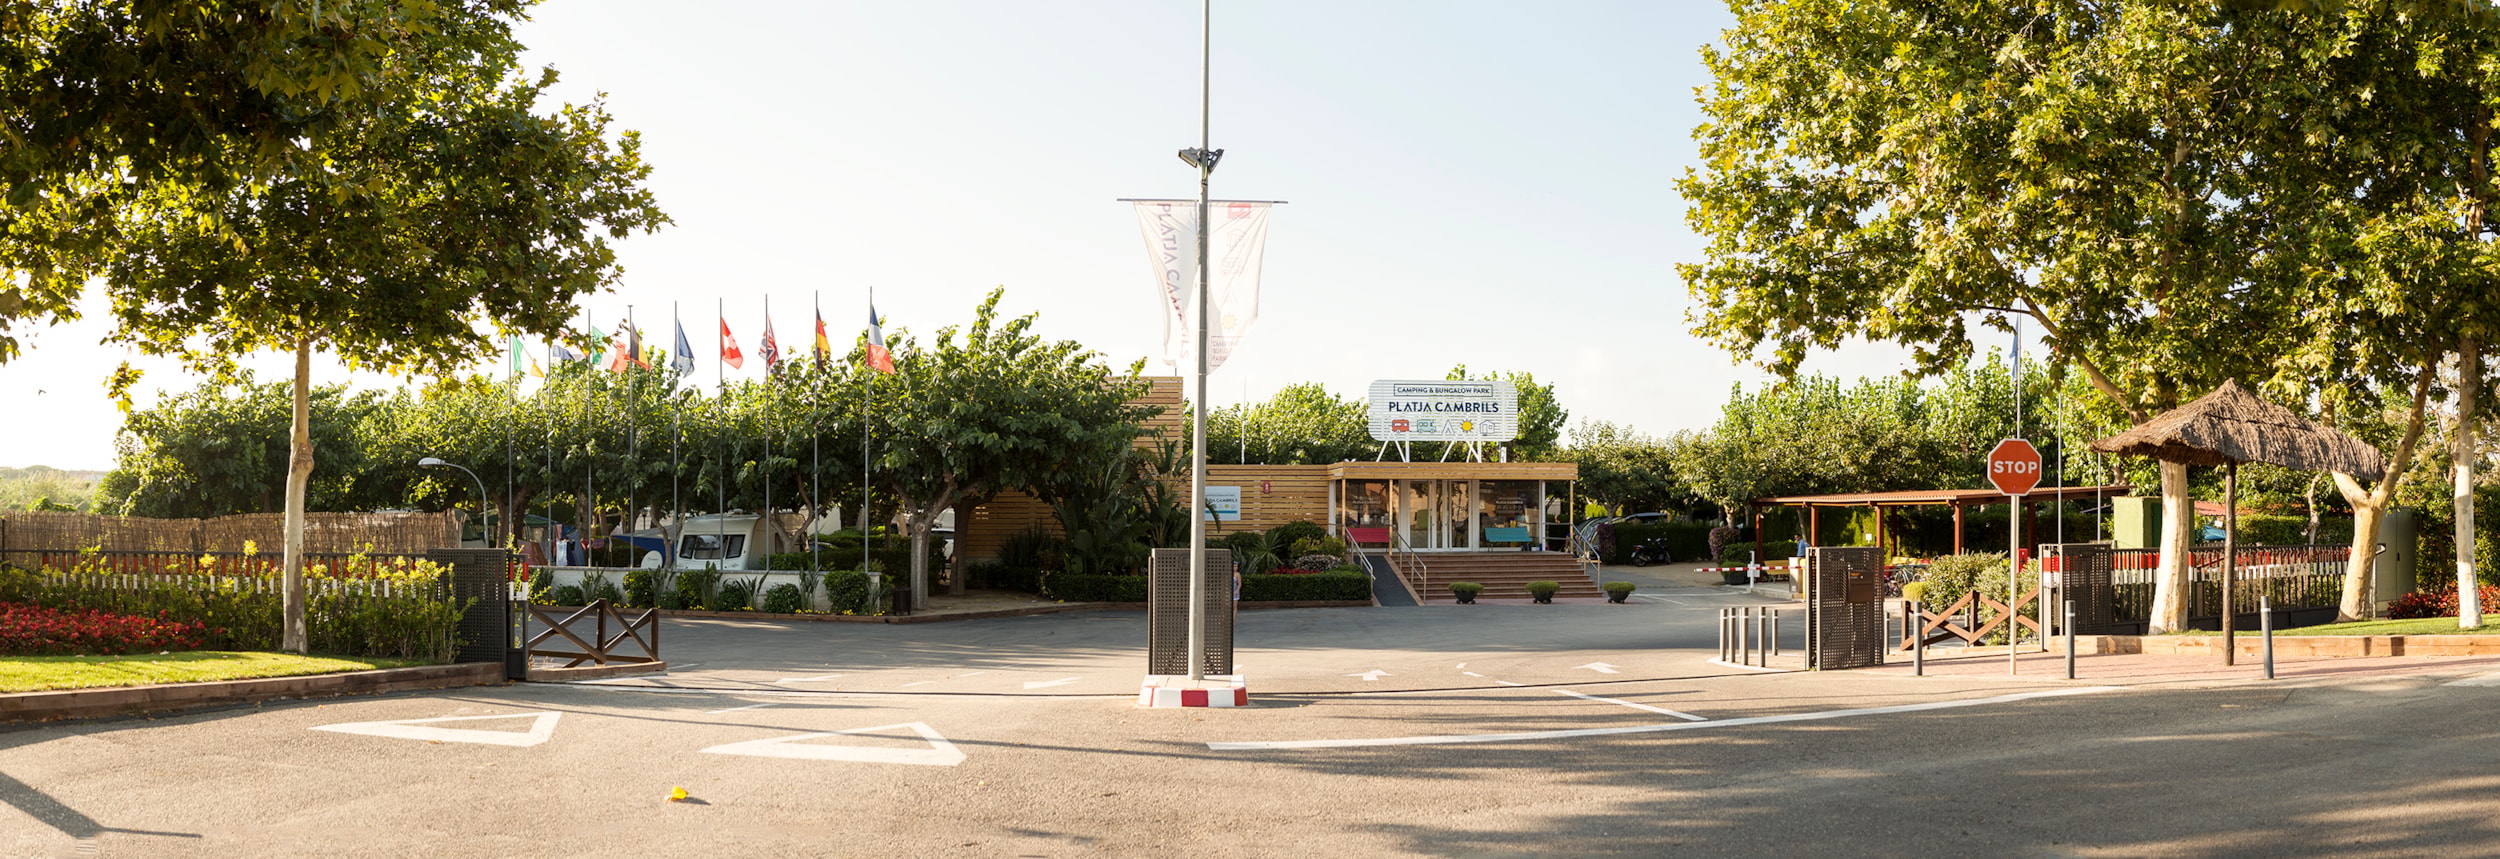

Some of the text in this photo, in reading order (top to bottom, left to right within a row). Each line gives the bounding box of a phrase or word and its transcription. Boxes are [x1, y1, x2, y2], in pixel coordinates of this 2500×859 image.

[1157, 203, 1178, 264] PLATJA
[1389, 402, 1499, 413] PLATJA CAMBRILS
[1993, 460, 2038, 474] STOP
